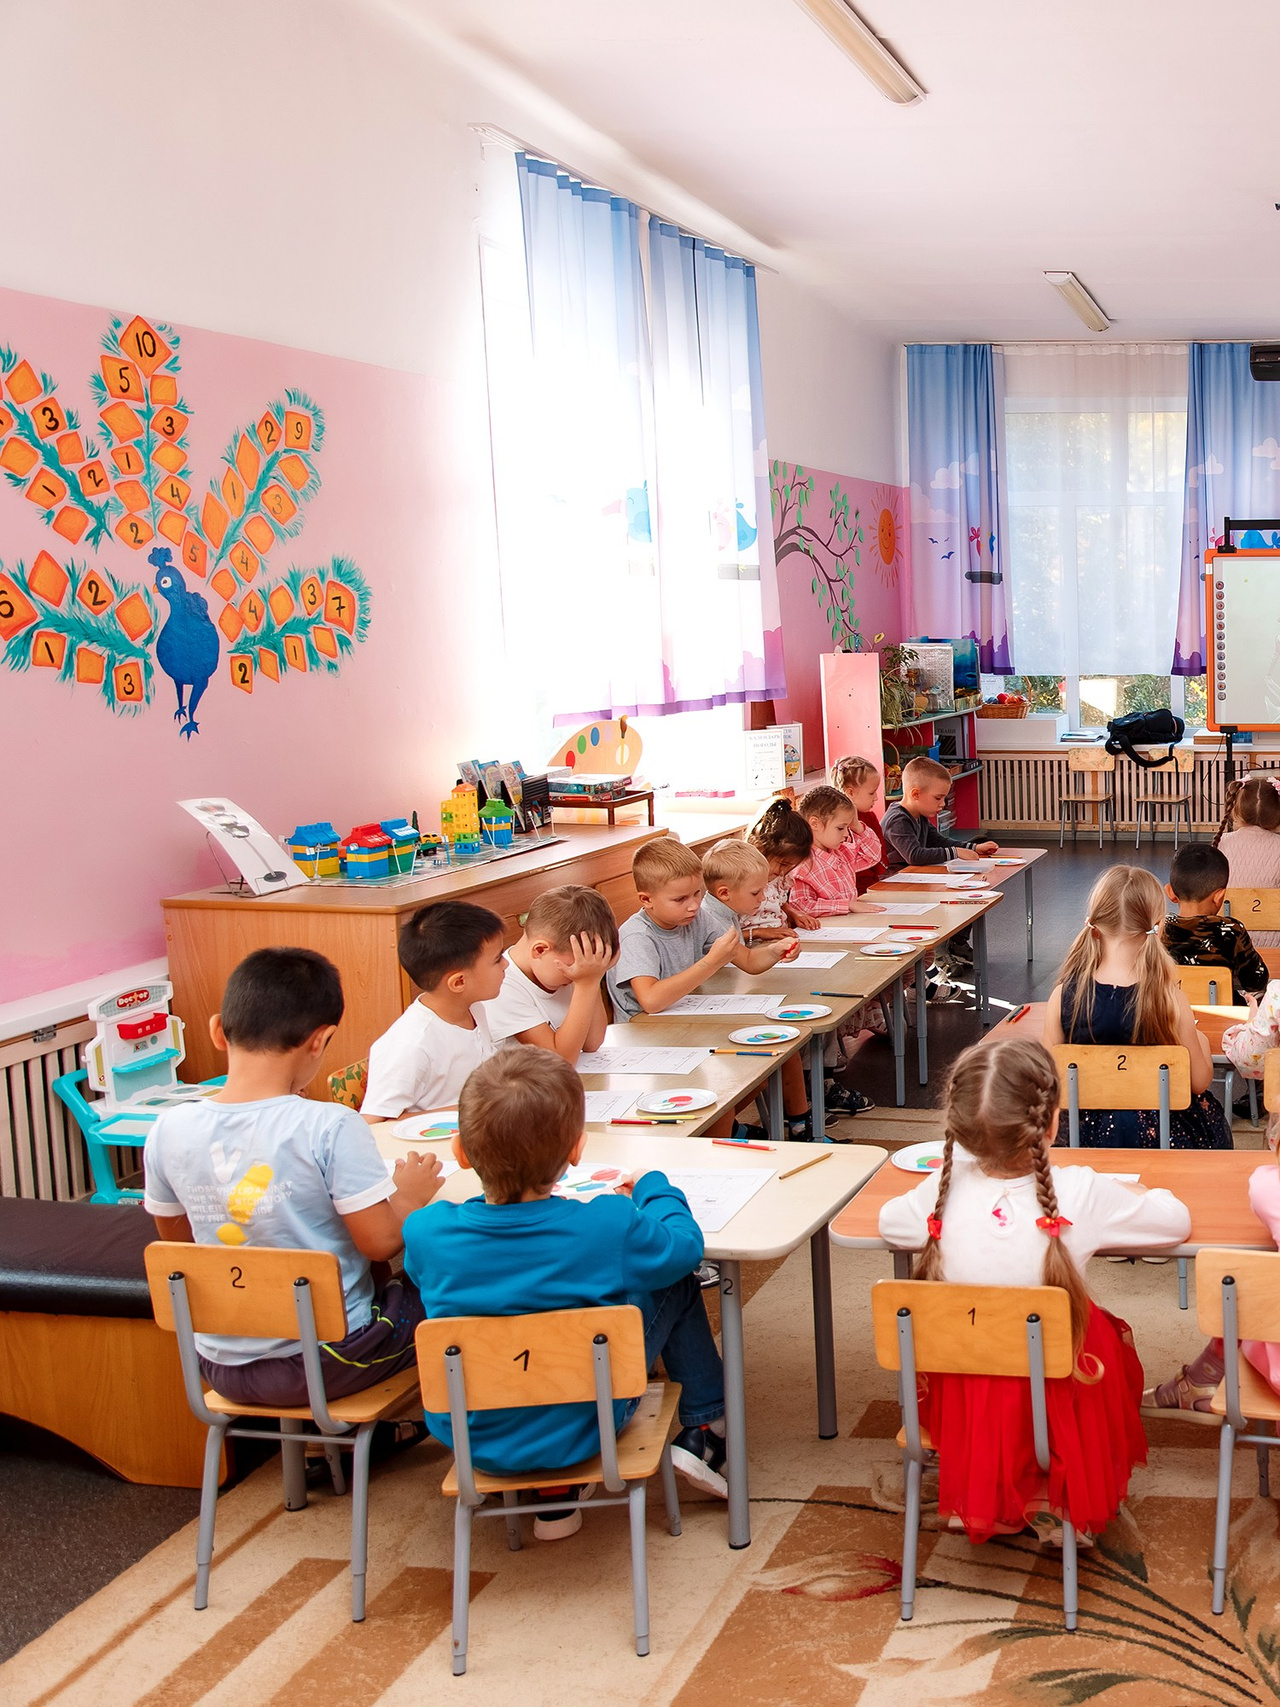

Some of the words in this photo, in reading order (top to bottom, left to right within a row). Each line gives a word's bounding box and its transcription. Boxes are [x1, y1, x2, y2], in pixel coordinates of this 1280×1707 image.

[136, 331, 157, 357] 10
[119, 367, 130, 393] 5
[42, 407, 60, 431] 3
[162, 416, 175, 436] 3
[264, 420, 276, 443] 2
[295, 422, 303, 440] 9
[126, 452, 131, 469] 1
[88, 469, 104, 488] 2
[42, 485, 56, 497] 1
[171, 484, 182, 504] 4
[272, 494, 283, 515] 3
[130, 523, 143, 544] 2
[188, 545, 199, 562] 5
[240, 551, 249, 572] 4
[88, 580, 107, 606] 2
[307, 584, 317, 605] 3
[249, 599, 258, 621] 4
[331, 596, 346, 617] 7
[45, 641, 55, 664] 1
[123, 673, 135, 695] 3
[238, 663, 249, 684] 2
[1252, 899, 1261, 912] 2
[1118, 1054, 1127, 1071] 2
[231, 1266, 246, 1289] 2
[723, 1278, 733, 1295] 2
[968, 1307, 976, 1326] 1
[513, 1349, 530, 1372] 1
